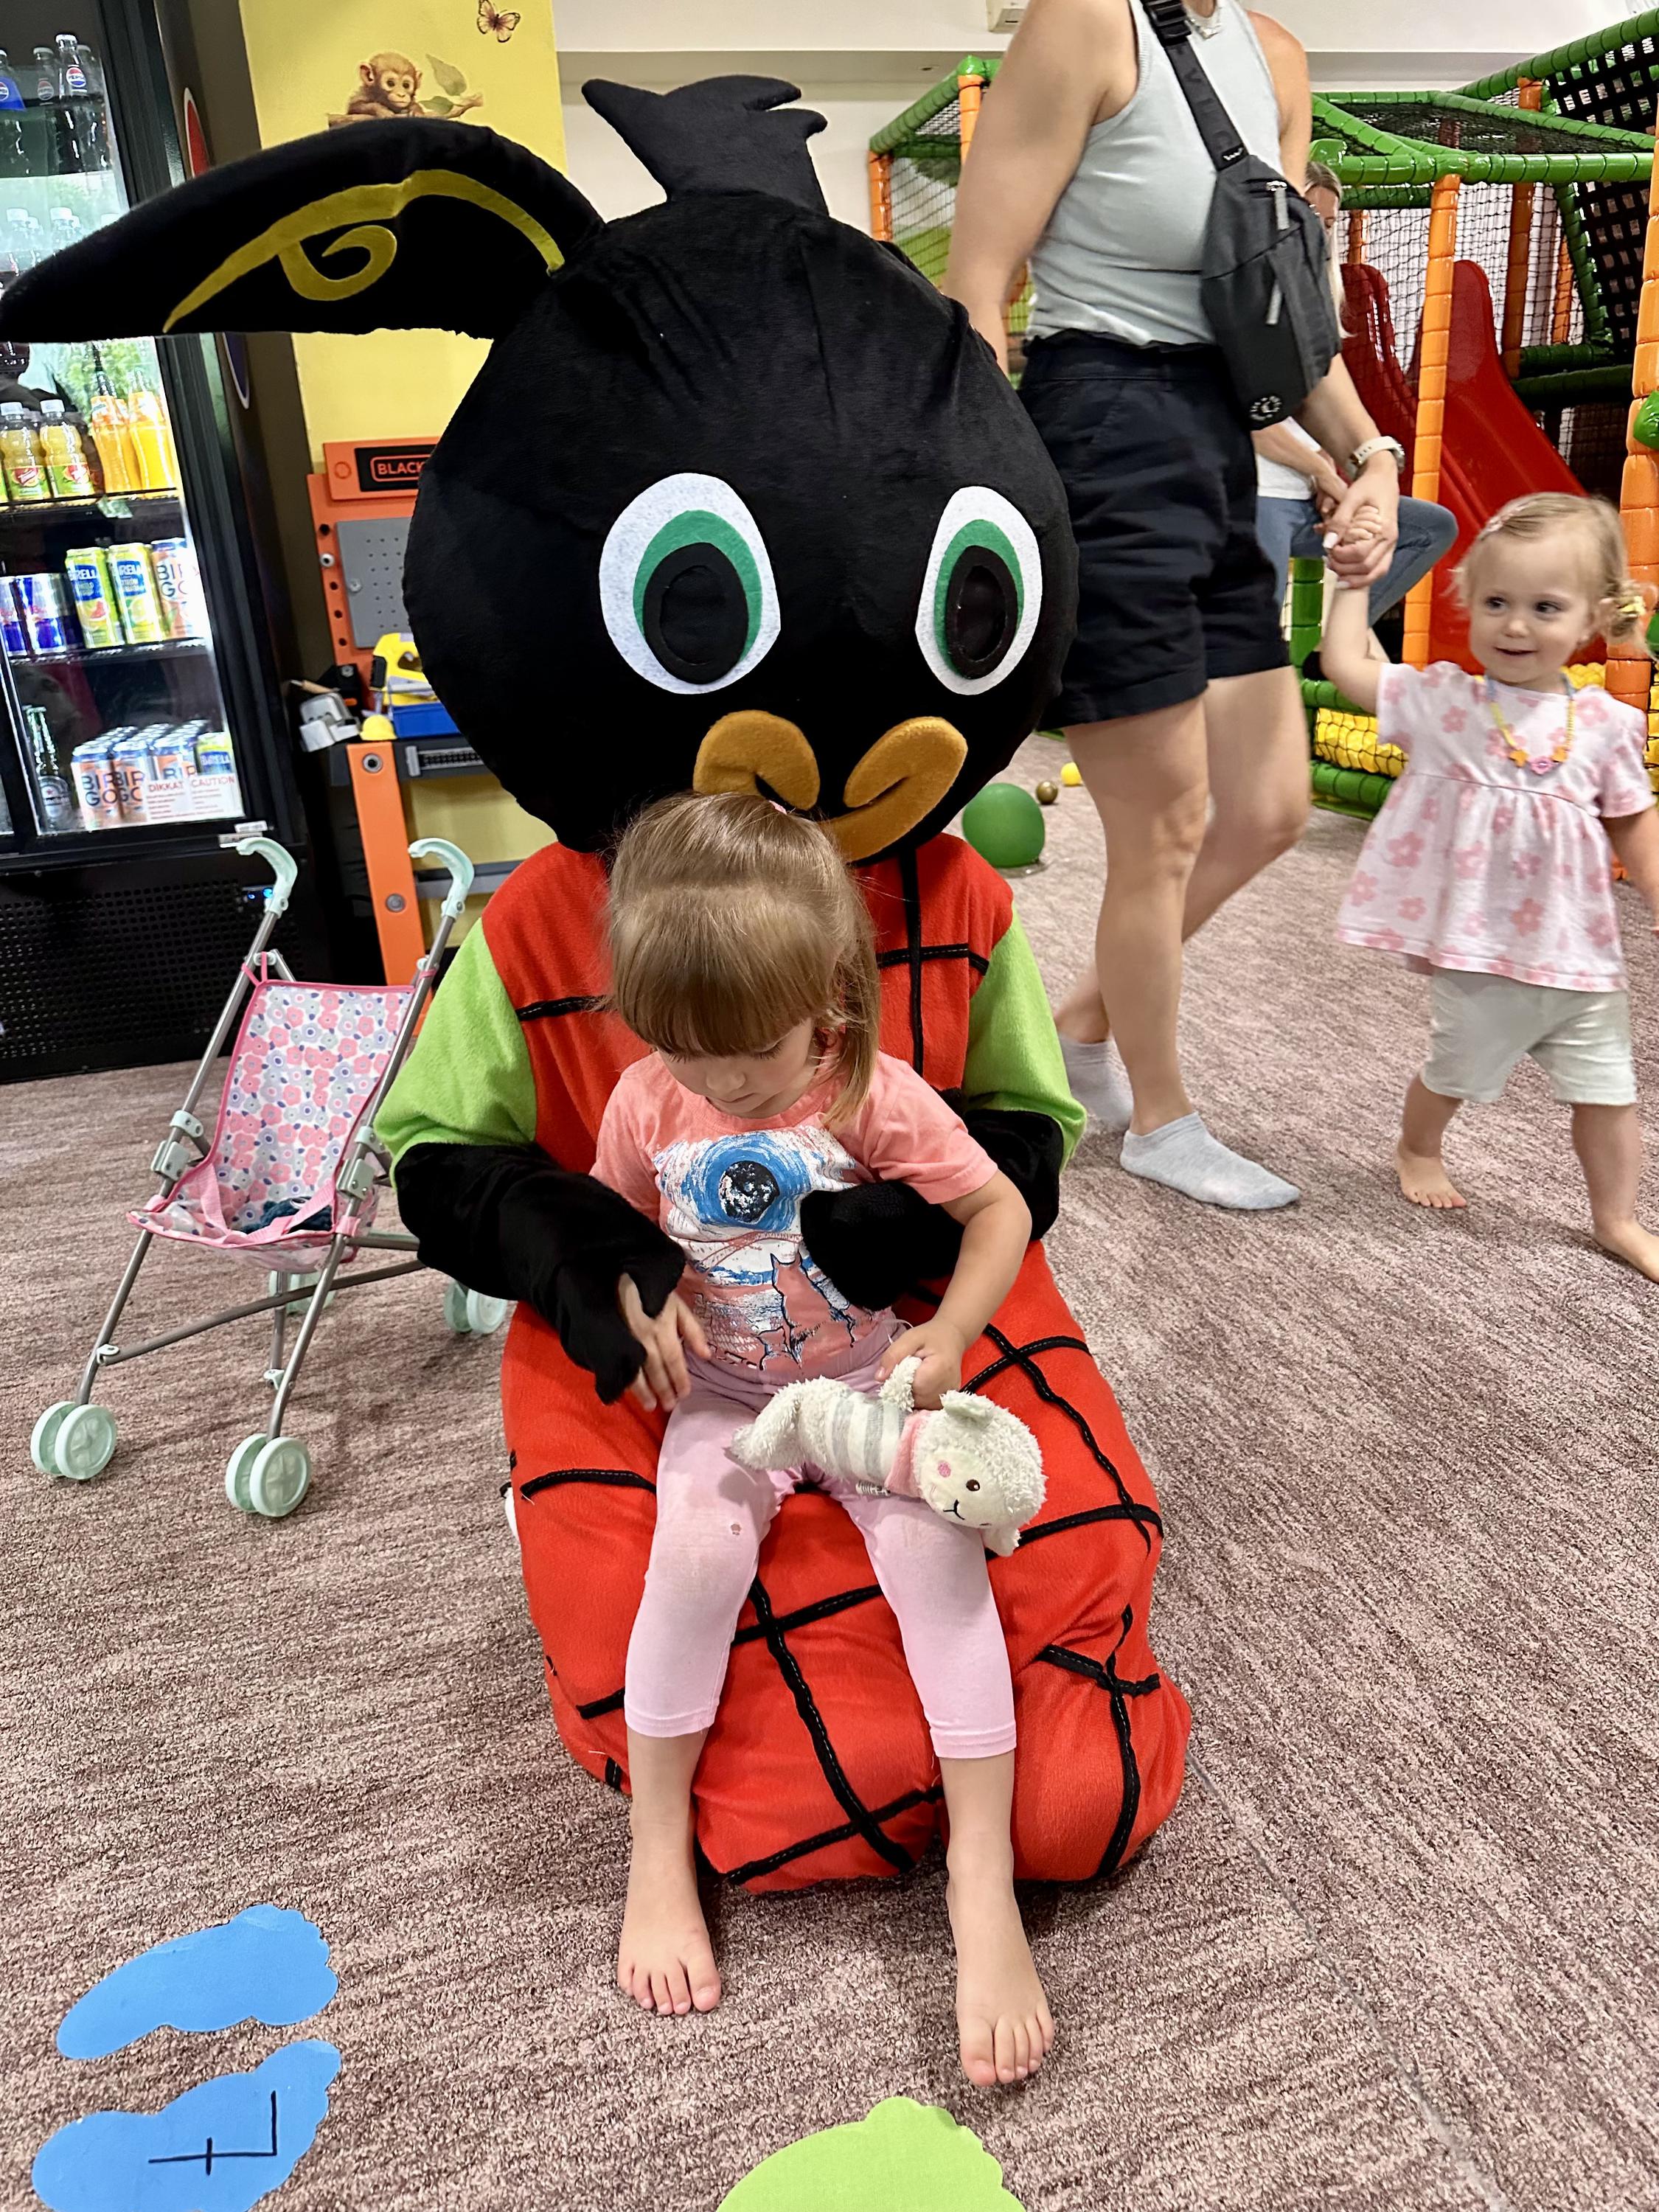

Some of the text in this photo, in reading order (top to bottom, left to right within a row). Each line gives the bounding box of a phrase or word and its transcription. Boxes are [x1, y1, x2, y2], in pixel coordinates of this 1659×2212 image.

[377, 461, 425, 475] BLACK
[190, 776, 234, 787] CAUTION
[85, 789, 117, 806] GO
